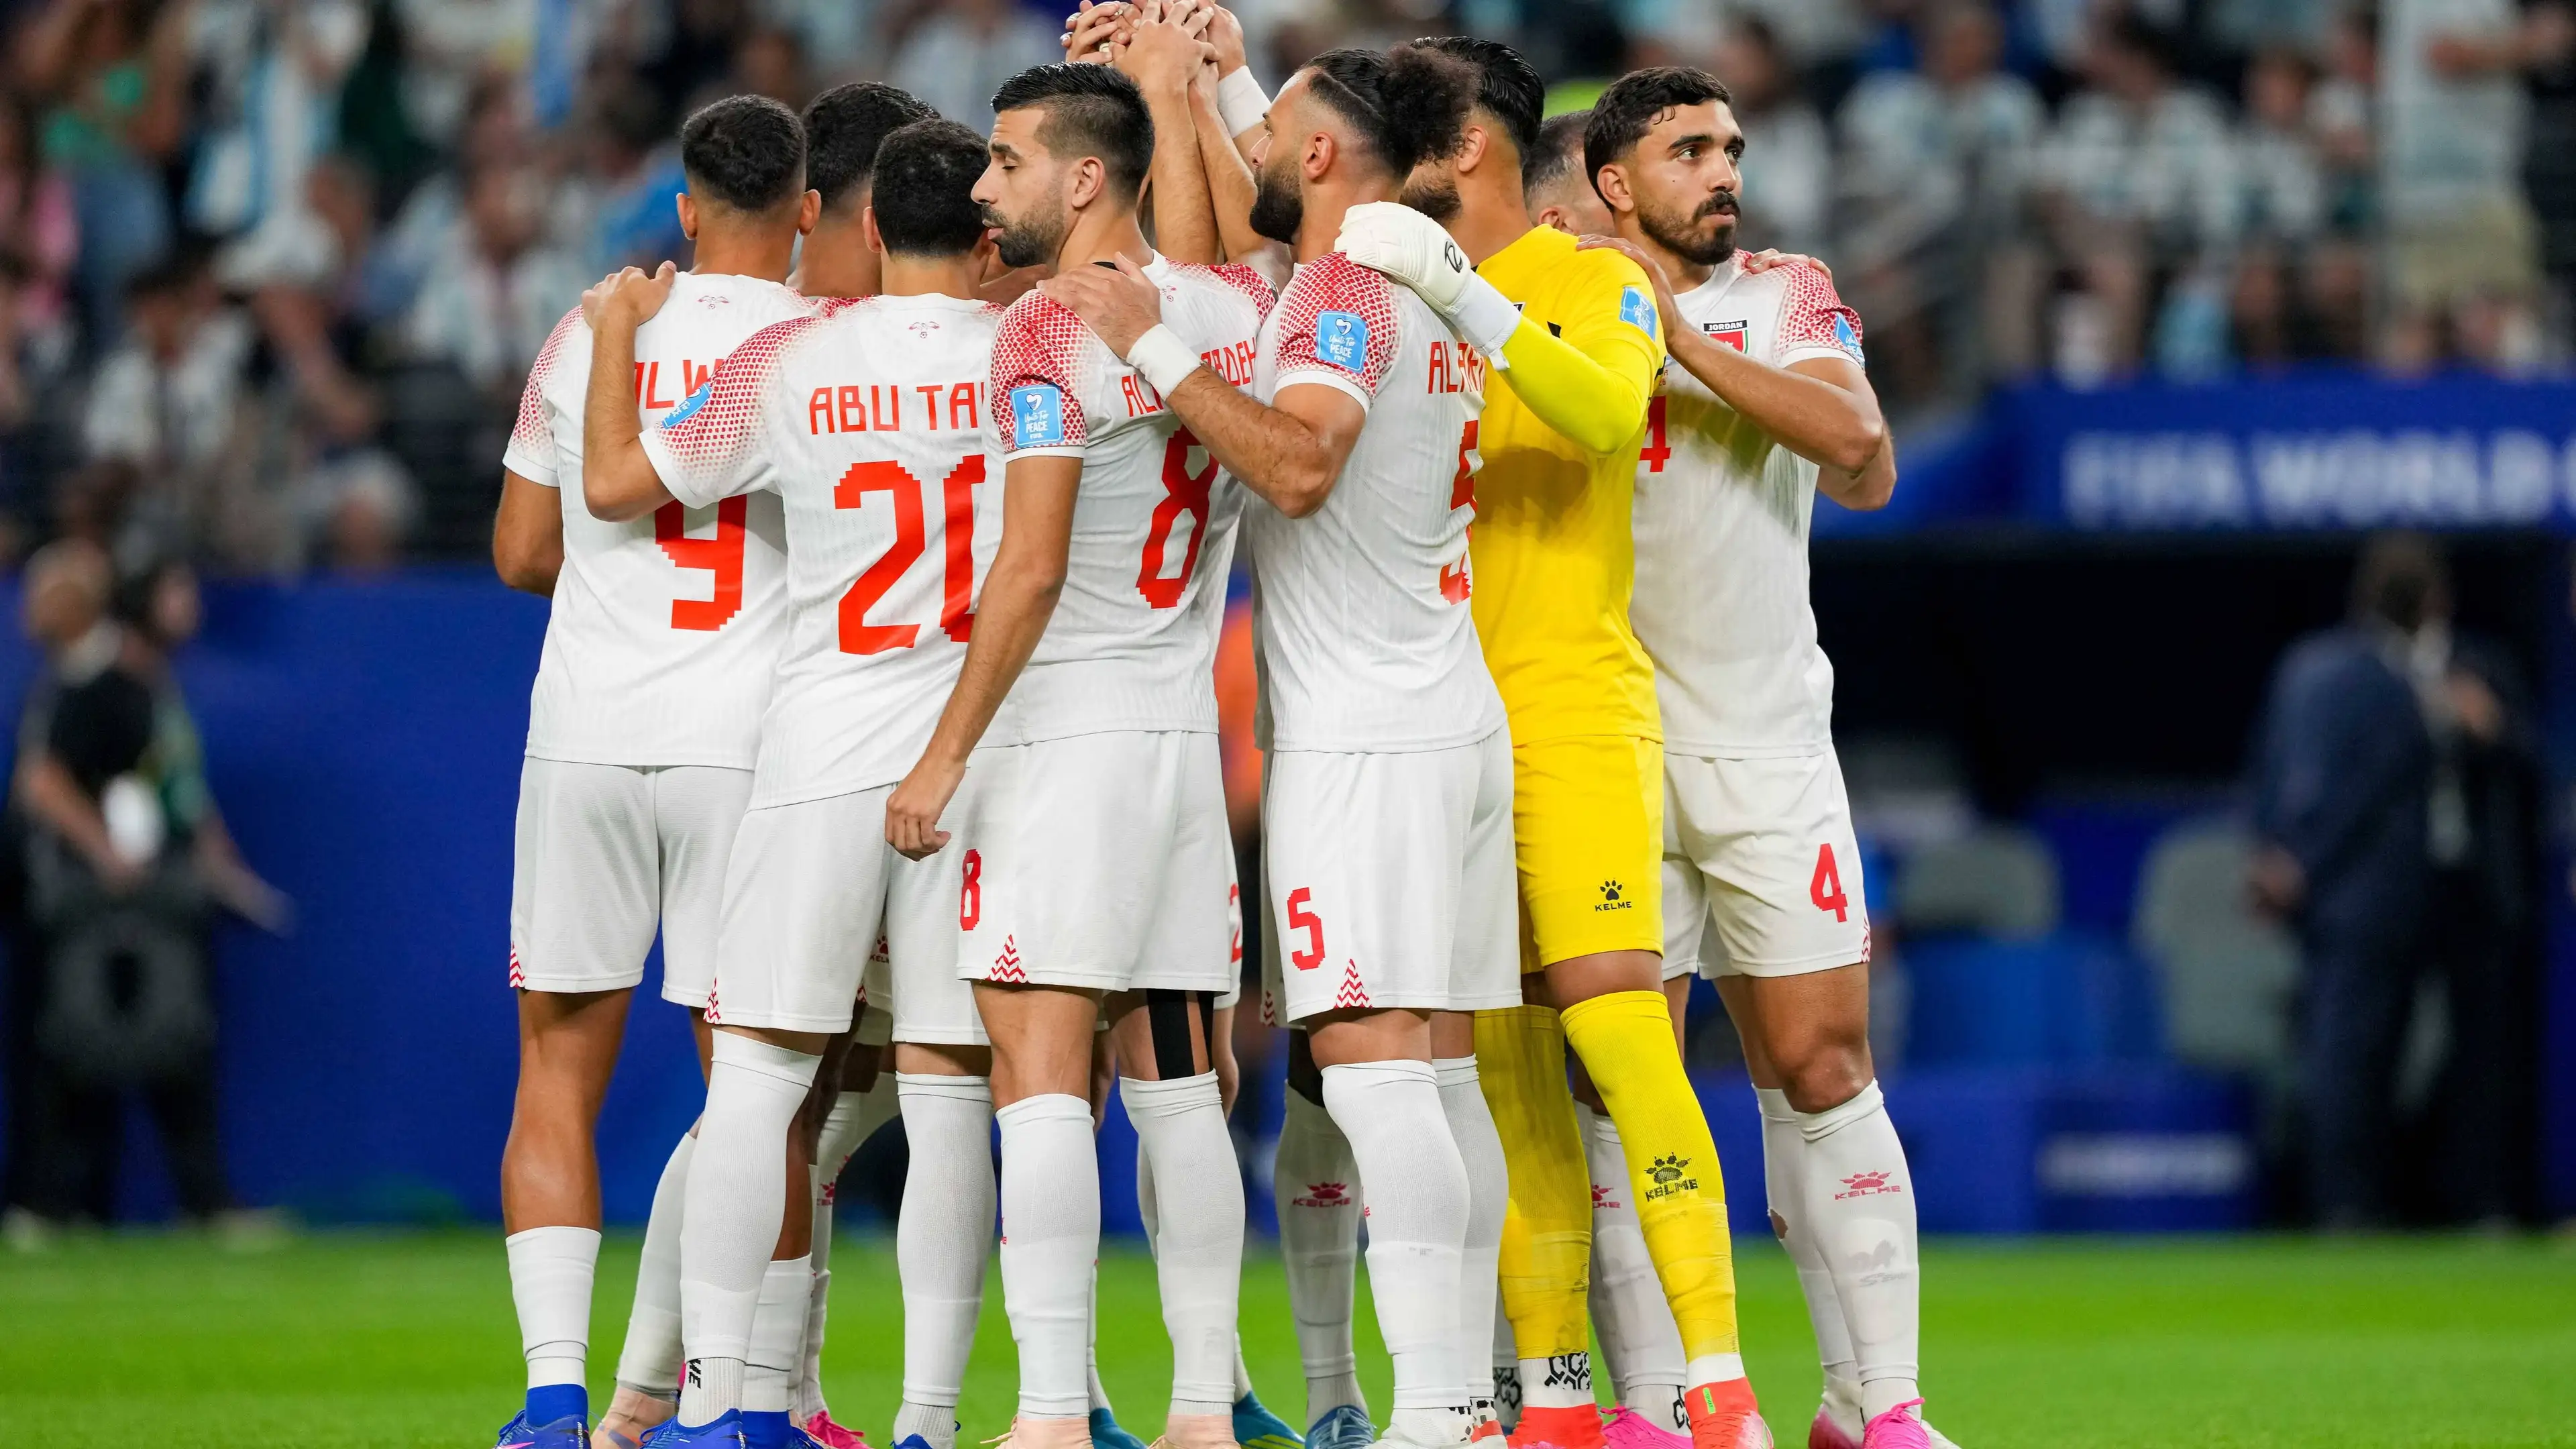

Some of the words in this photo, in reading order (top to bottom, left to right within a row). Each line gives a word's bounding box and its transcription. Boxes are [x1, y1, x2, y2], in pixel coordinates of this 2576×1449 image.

[1709, 322, 1743, 331] JORDAN
[1330, 343, 1352, 358] PEACE
[809, 385, 900, 435] ABU
[916, 382, 984, 431] TA
[1026, 421, 1049, 433] PEACE
[1135, 424, 1220, 609] 8
[959, 849, 981, 931] 8
[1810, 843, 1848, 923] 4
[1595, 902, 1631, 912] KELME
[1287, 887, 1326, 971] 5
[1646, 1179, 1698, 1202] KELME
[1835, 1185, 1901, 1200] KELME
[1292, 1197, 1350, 1207] KELME
